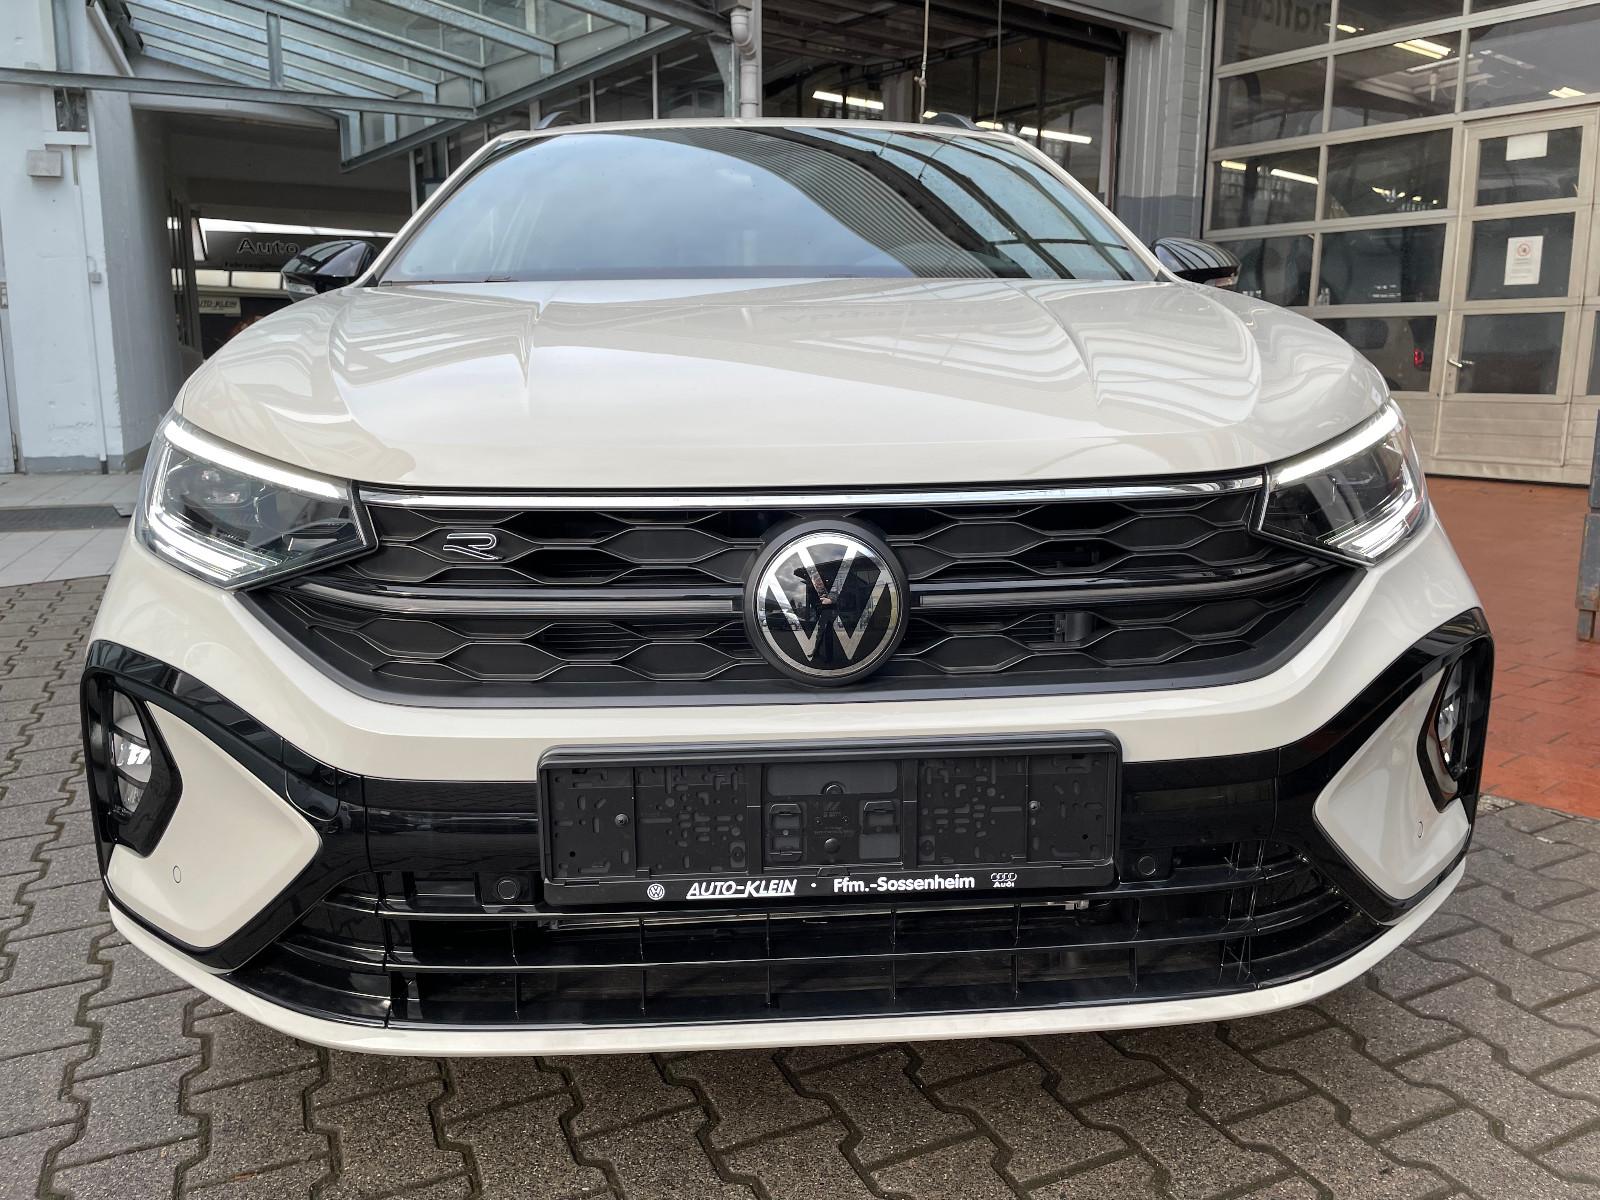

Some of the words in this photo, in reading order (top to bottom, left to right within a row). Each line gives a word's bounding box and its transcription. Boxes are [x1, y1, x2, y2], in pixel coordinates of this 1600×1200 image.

[237, 238, 300, 255] Auto
[686, 879, 797, 899] AUTO-KLEIN
[833, 874, 975, 893] Ffm.-Sossenheim
